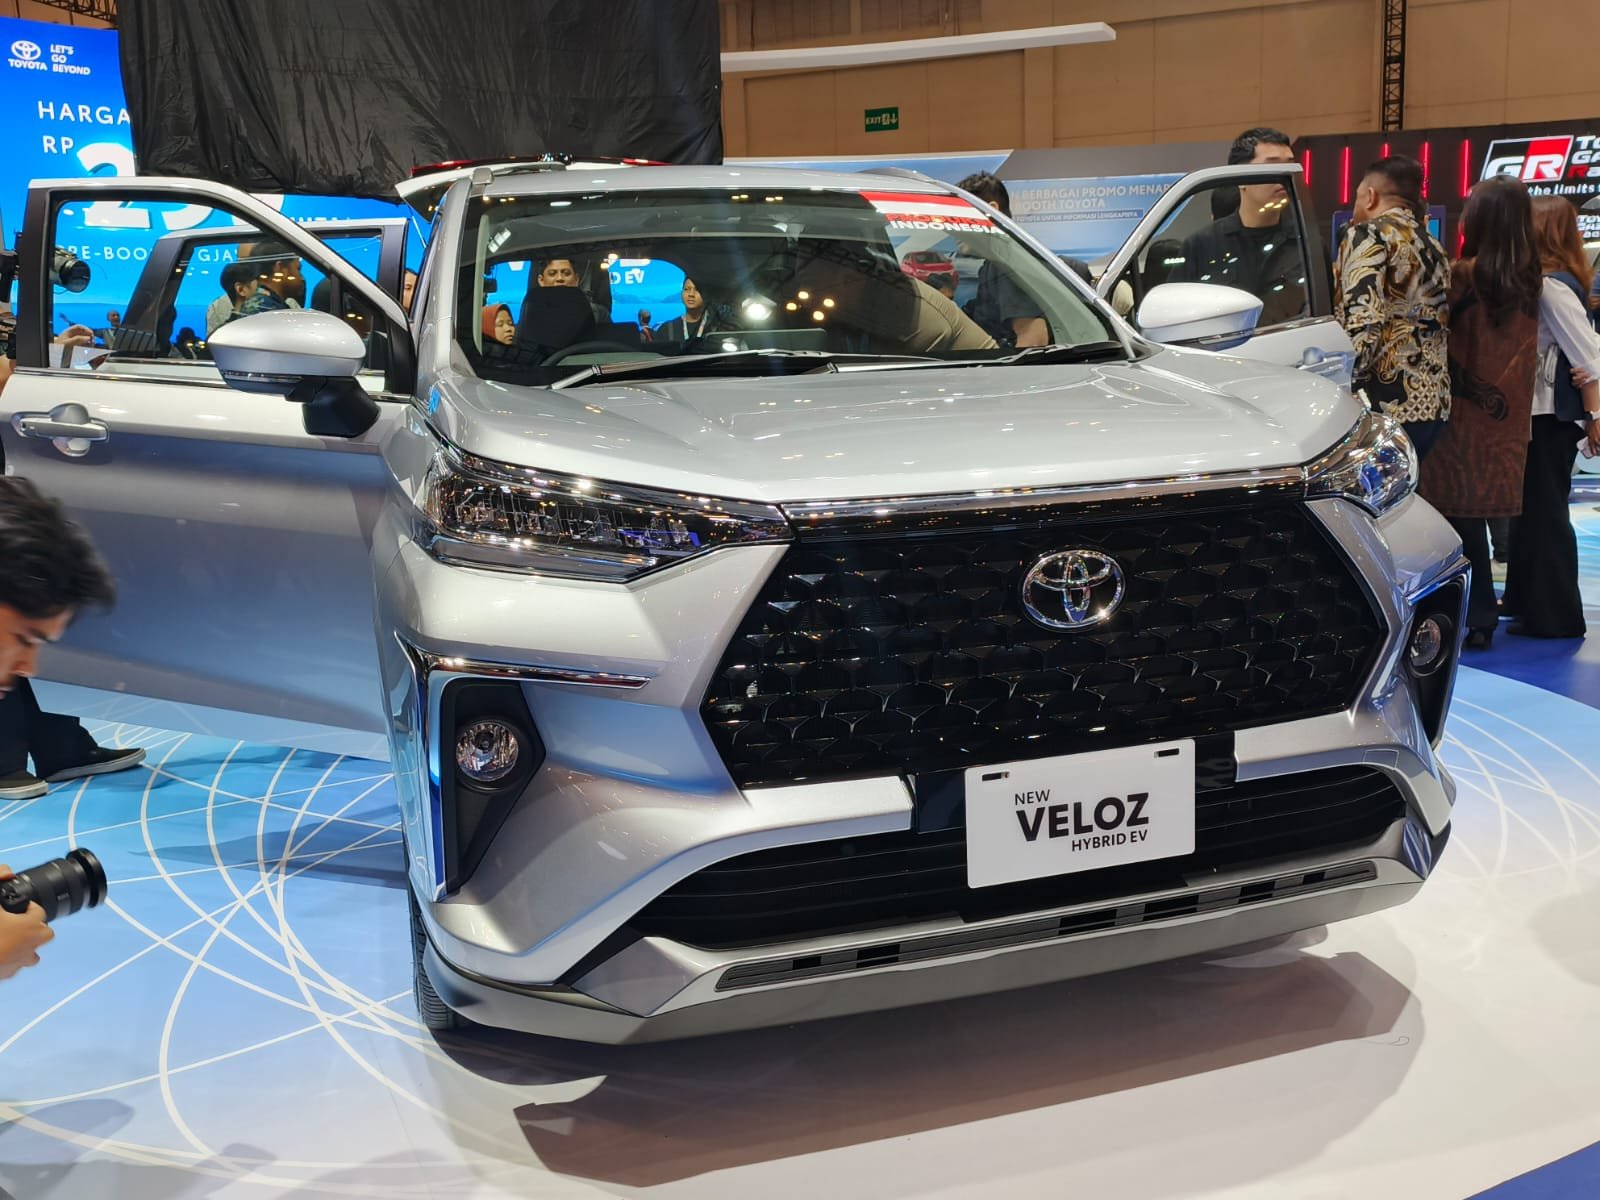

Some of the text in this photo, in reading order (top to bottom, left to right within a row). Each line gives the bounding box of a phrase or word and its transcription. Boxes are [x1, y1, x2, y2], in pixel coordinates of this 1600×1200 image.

[50, 44, 74, 55] LET'S
[8, 58, 48, 71] TOYOTA
[51, 54, 67, 63] GO
[52, 63, 91, 75] BEYOND
[38, 100, 131, 125] HARGA
[866, 116, 881, 125] EXIT
[42, 135, 74, 154] RP
[1484, 153, 1564, 180] GR
[1082, 185, 1126, 198] PROMO
[1528, 183, 1595, 196] the limits
[1059, 198, 1105, 210] TOYOTA
[889, 220, 1007, 235] INDONESIA
[1014, 789, 1050, 806] NEW
[1015, 792, 1149, 842] VELOZ
[1071, 829, 1148, 852] HYBRID EV
